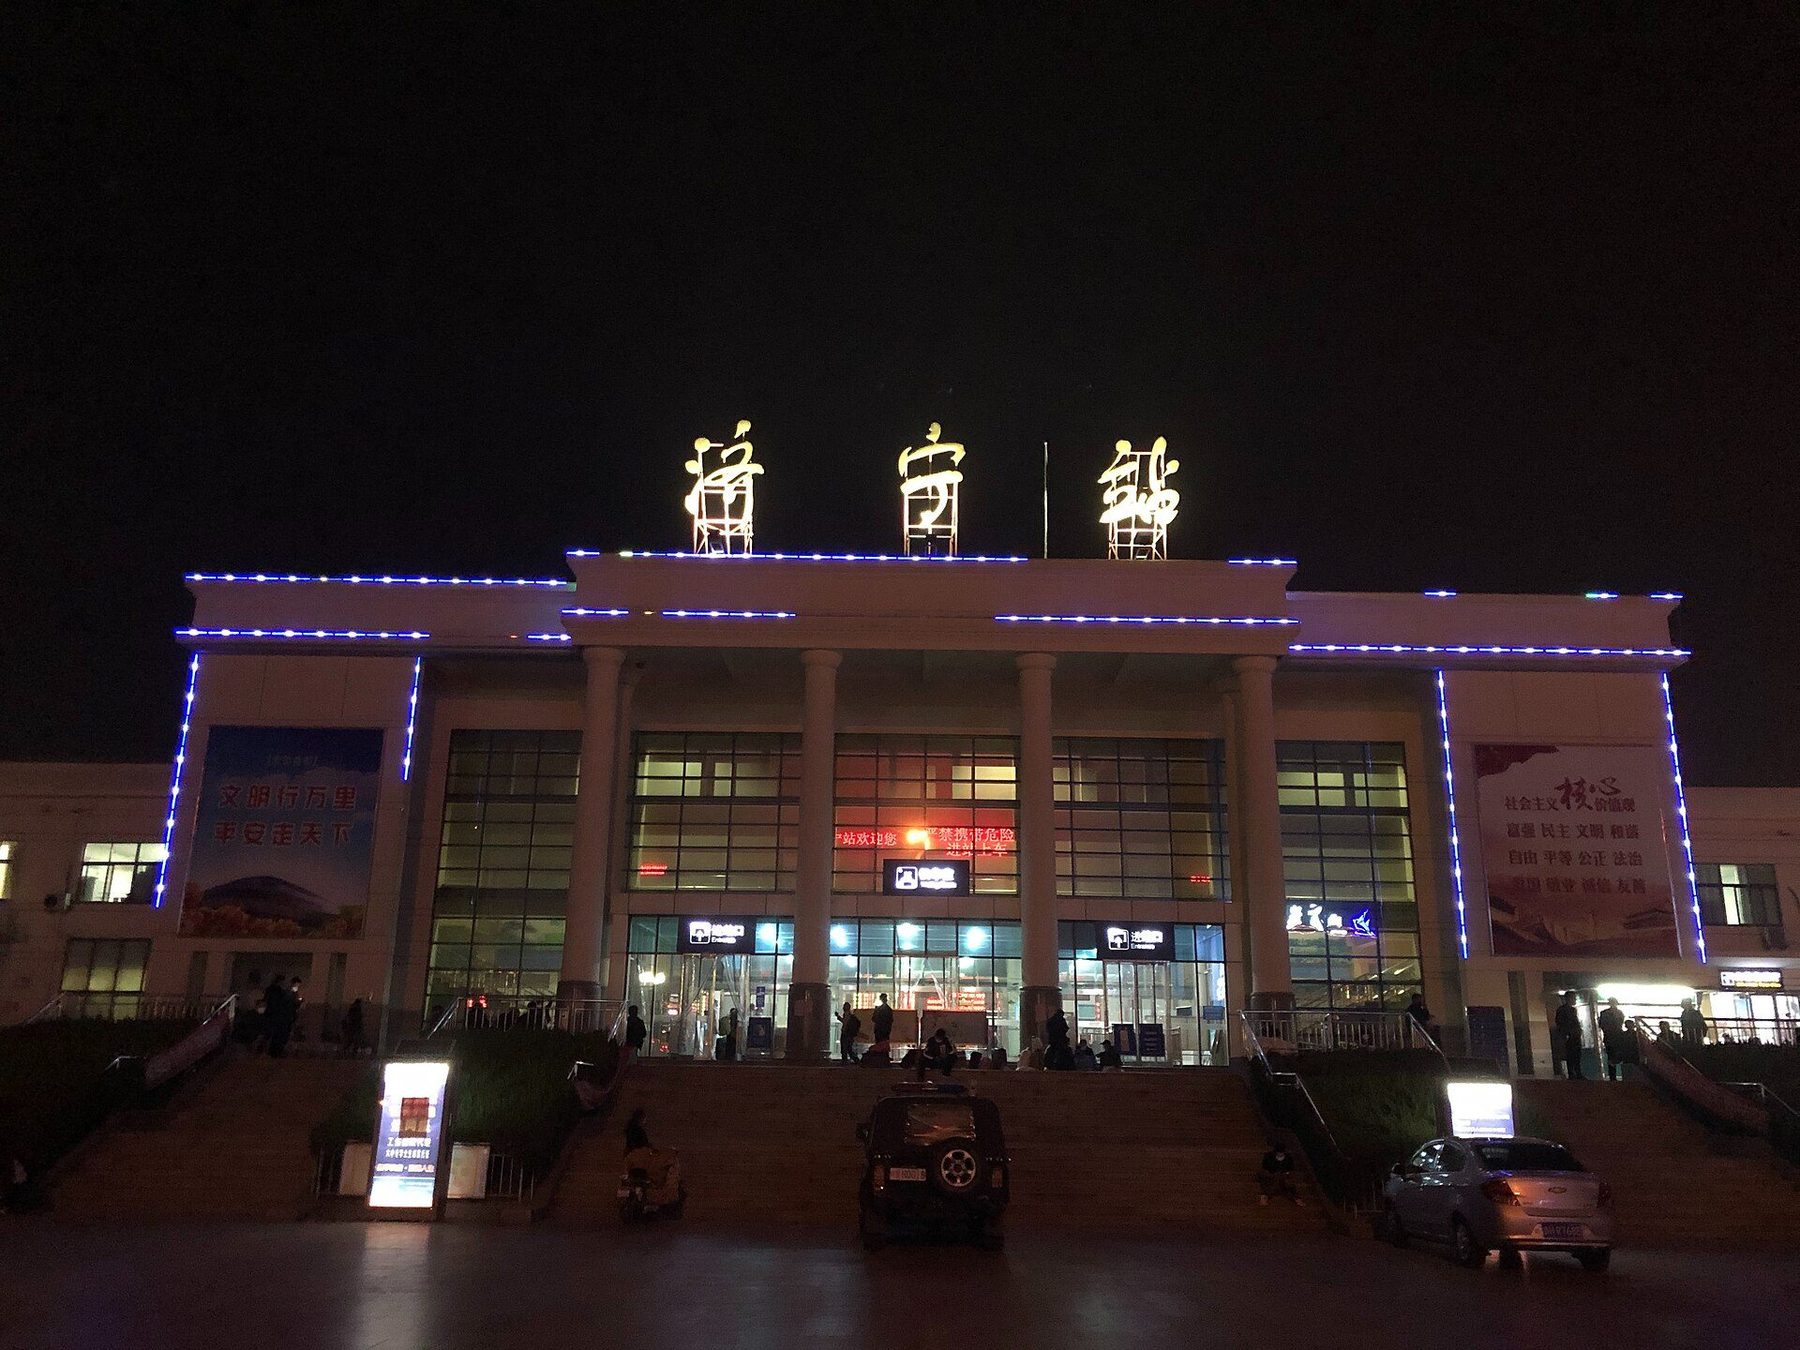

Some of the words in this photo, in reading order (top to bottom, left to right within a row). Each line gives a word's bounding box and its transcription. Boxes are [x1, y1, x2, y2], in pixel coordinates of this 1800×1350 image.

[218, 784, 358, 809] 文明行万里
[213, 821, 354, 846] 平安走天下
[1507, 823, 1536, 838] 富强
[1541, 823, 1570, 838] 民主
[1576, 823, 1605, 839] 文明
[1610, 823, 1639, 839] 和谐
[1508, 850, 1538, 865] 自由
[1544, 850, 1572, 866] 平等
[1578, 851, 1606, 866] 公正
[1613, 851, 1642, 866] 法治
